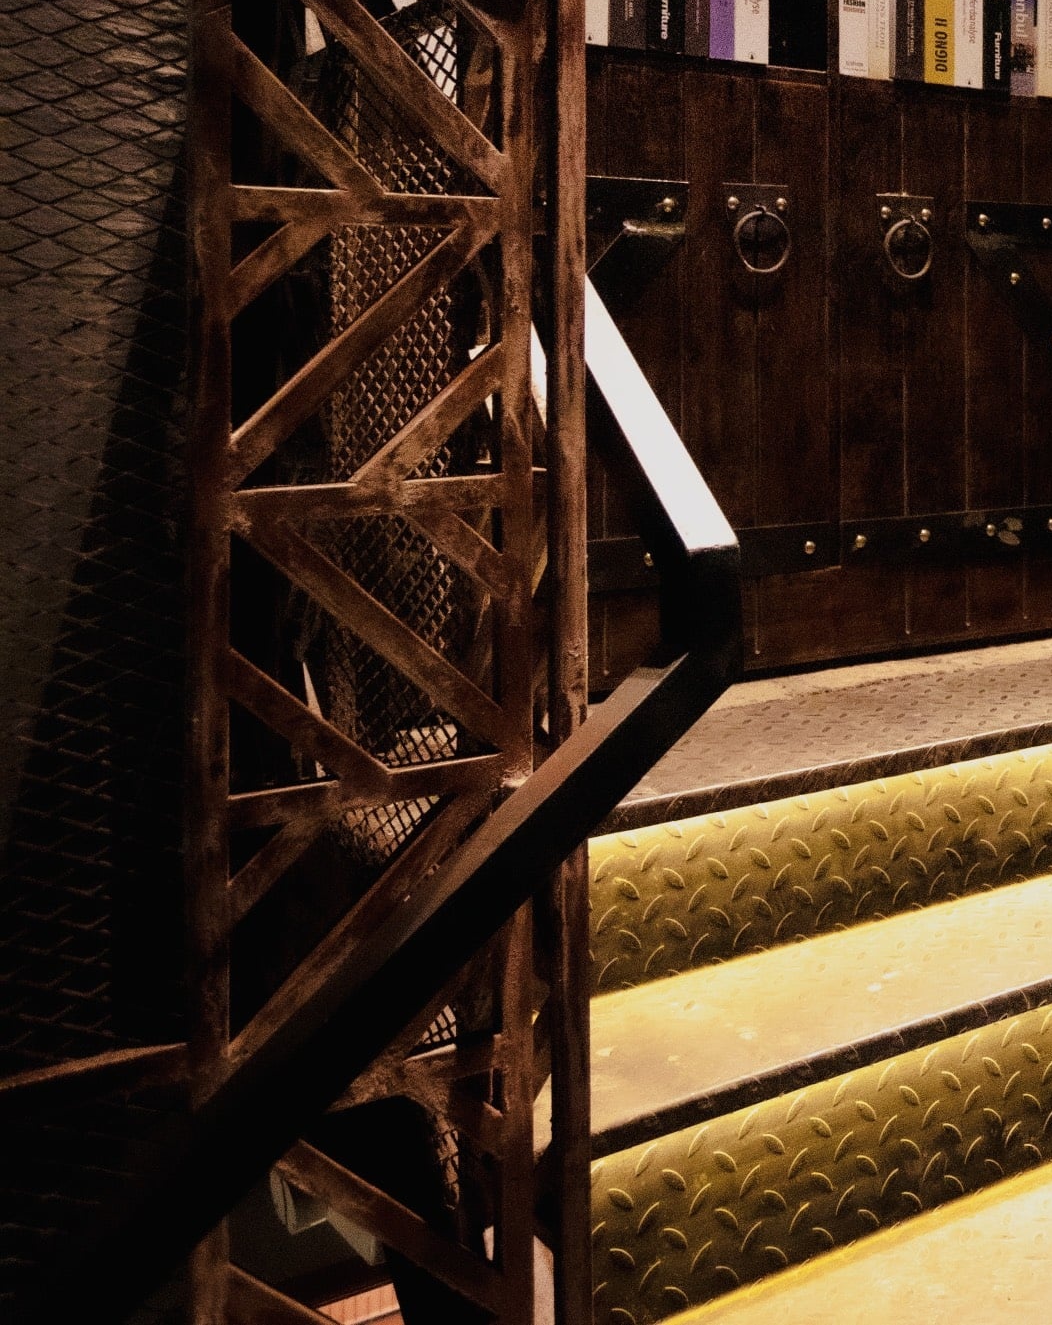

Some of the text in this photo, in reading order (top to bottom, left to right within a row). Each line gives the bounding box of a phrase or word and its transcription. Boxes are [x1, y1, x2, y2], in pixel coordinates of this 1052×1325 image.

[934, 16, 948, 73] DIGNO II
[994, 31, 1003, 81] Furniture
